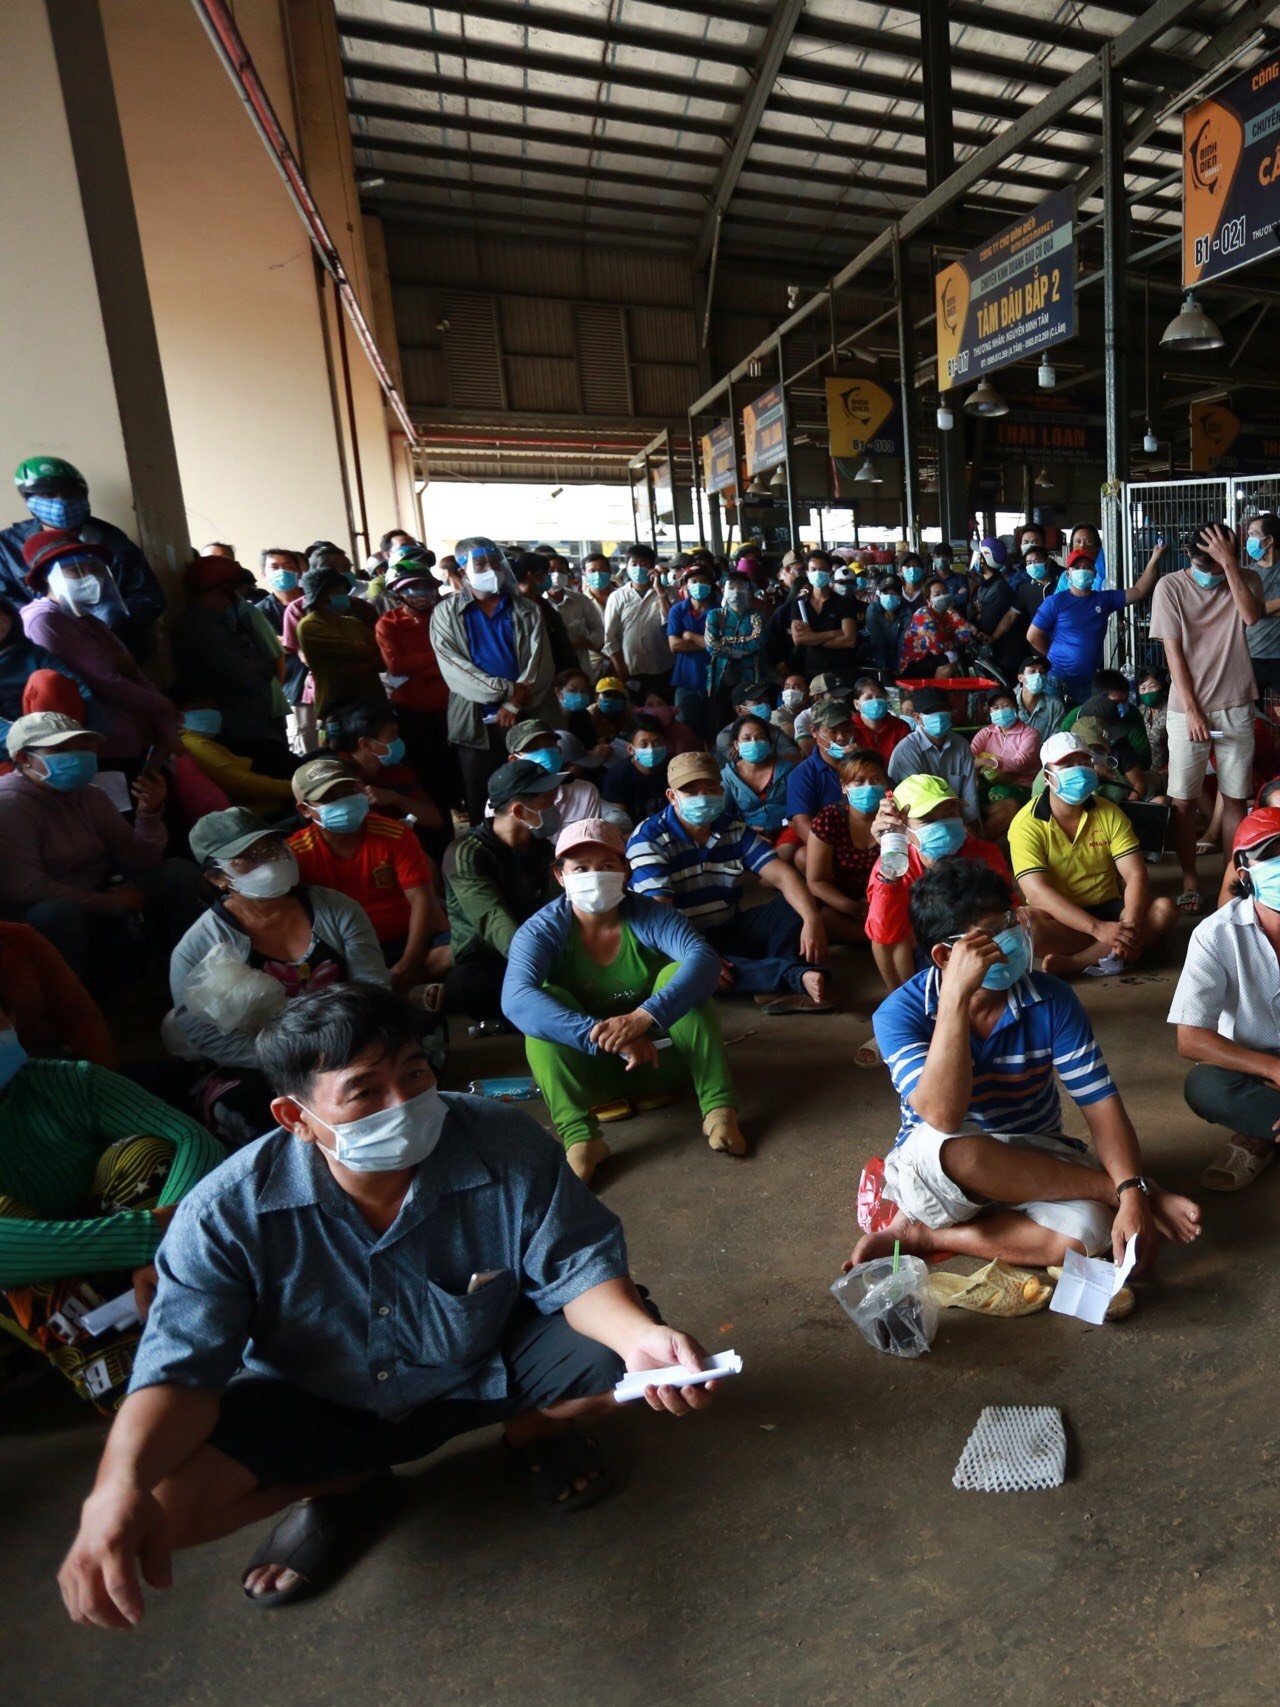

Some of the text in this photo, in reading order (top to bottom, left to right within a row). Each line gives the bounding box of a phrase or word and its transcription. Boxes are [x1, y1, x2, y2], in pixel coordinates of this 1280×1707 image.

[976, 301, 999, 339] TÂM
[1001, 286, 1022, 329] ĐẬU
[1025, 265, 1049, 315] BẮP
[1051, 268, 1060, 303] 2
